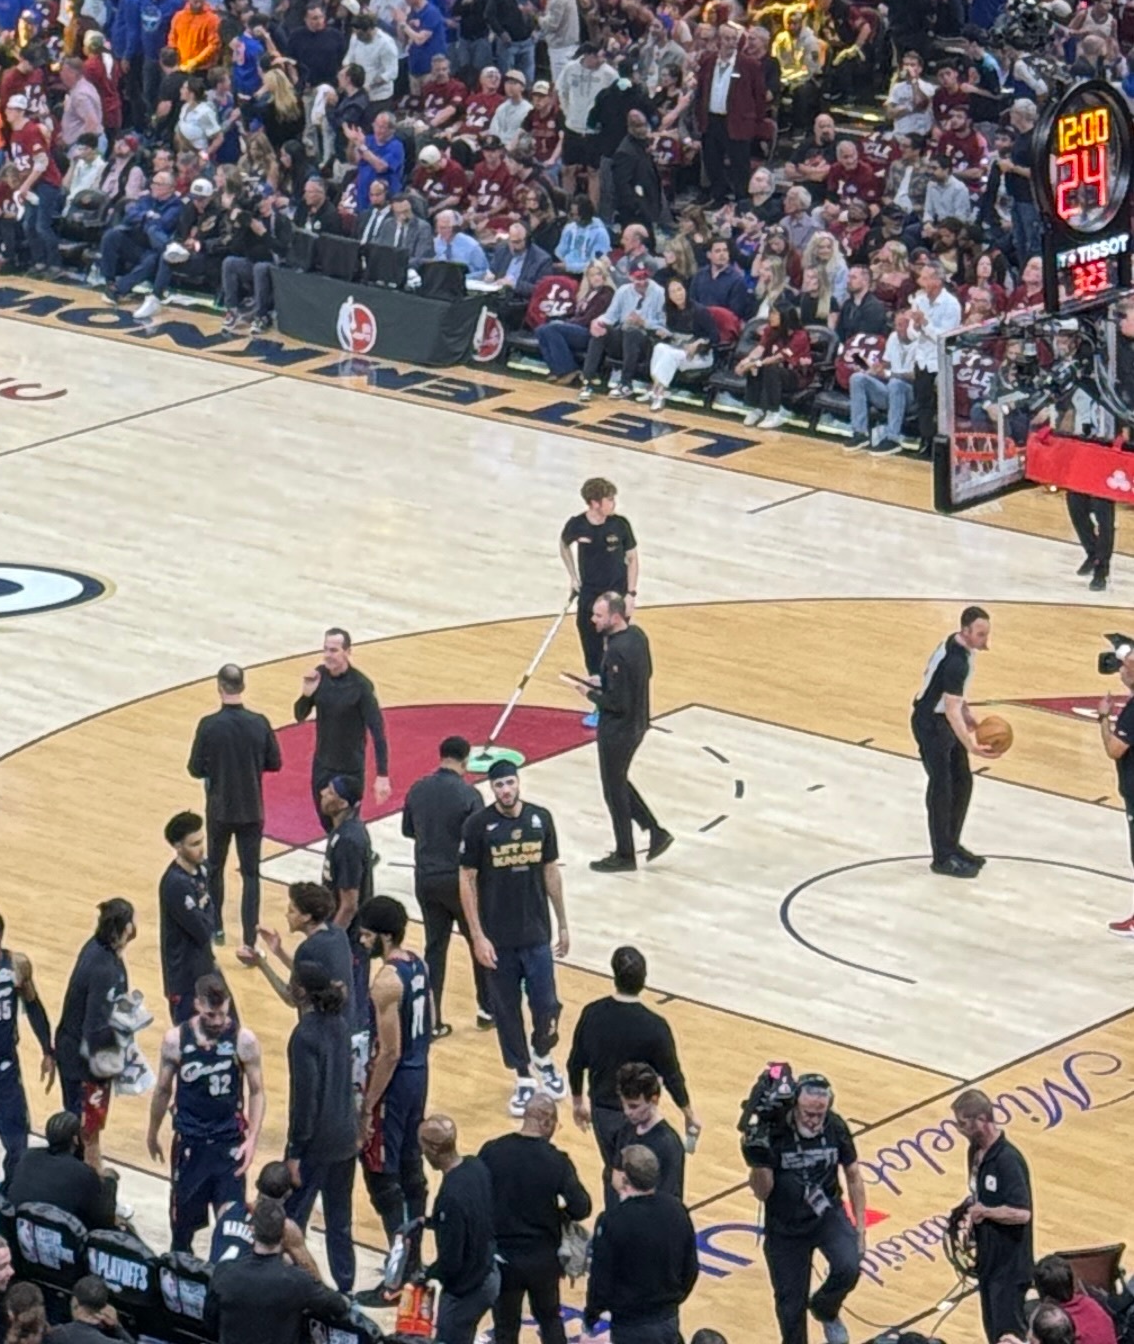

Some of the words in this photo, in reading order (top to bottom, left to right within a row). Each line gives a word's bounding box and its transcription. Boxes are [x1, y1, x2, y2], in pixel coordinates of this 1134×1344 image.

[1057, 107, 1109, 153] 12:00
[1055, 144, 1108, 221] 24
[1075, 233, 1130, 265] TISSOT
[307, 357, 515, 405] EM
[491, 400, 763, 459] LET
